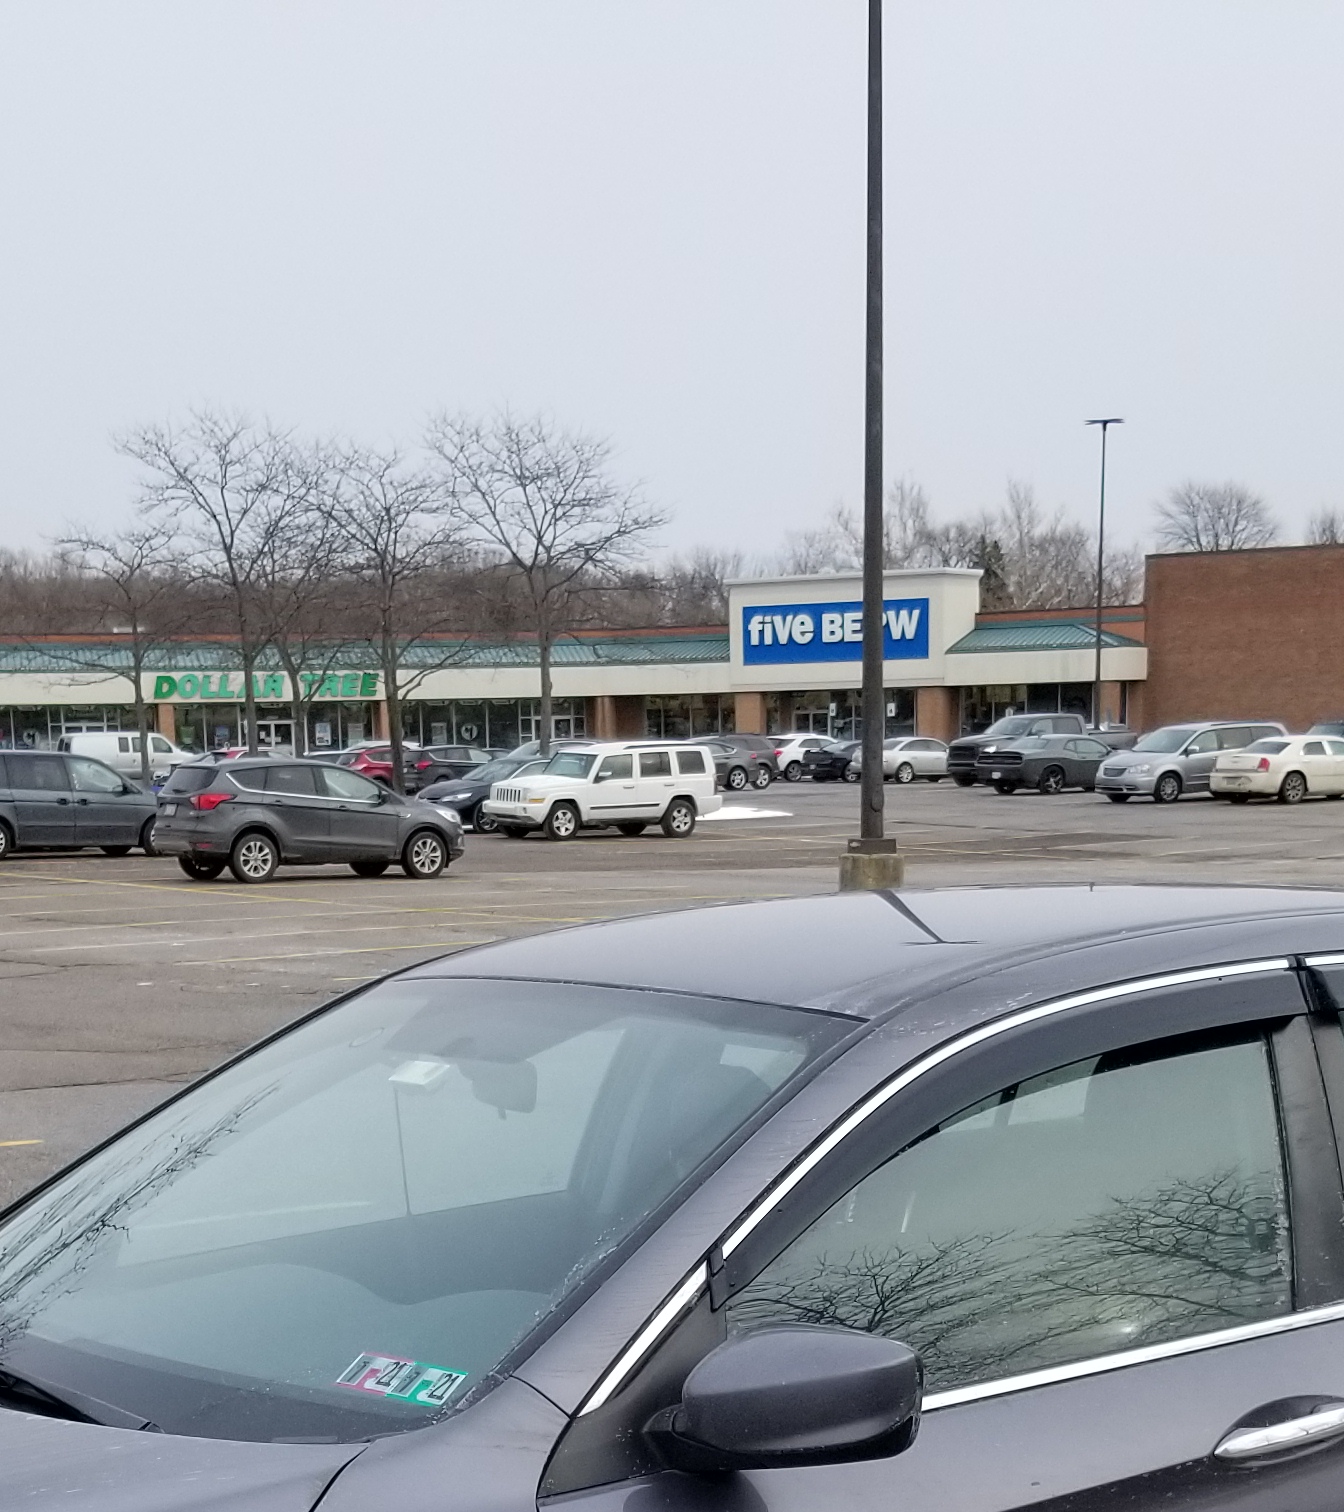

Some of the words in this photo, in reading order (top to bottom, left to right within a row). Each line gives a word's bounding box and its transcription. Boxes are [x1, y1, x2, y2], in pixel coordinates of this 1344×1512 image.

[748, 614, 814, 646] five
[822, 609, 920, 643] BEW
[154, 673, 284, 699] DOLLAR
[300, 672, 378, 698] TREE
